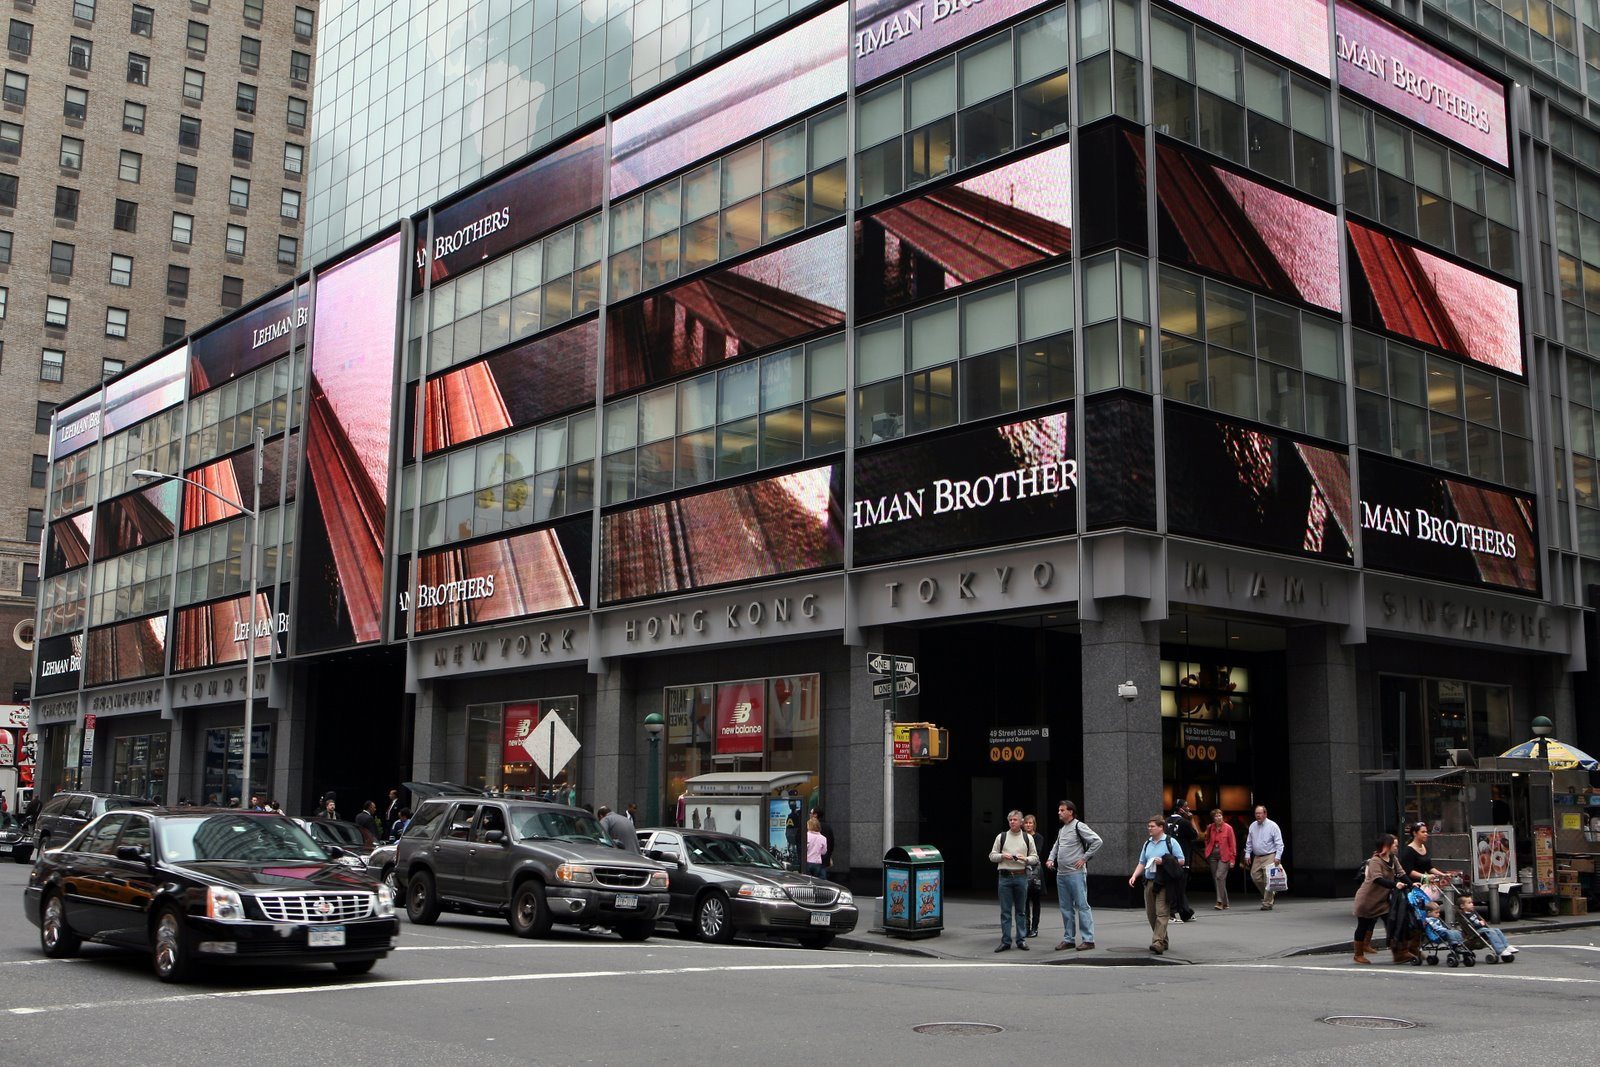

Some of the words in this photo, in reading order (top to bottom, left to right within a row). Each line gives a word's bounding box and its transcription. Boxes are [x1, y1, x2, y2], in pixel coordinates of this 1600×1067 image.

[1336, 32, 1387, 81] MAN
[1393, 56, 1490, 133] BROTHERS
[434, 206, 510, 260] BROTHERS
[252, 316, 293, 349] LEHMAN
[61, 417, 89, 443] LEHMAN
[1359, 501, 1410, 536] MAN
[1416, 508, 1516, 559] BROTHERS
[418, 575, 494, 608] BROTHERS
[885, 560, 1056, 609] TOKYO
[1184, 560, 1329, 608] MIAMI
[624, 609, 705, 642] HONG
[726, 593, 817, 630] KONG
[1381, 592, 1552, 643] SINGAPORE
[434, 640, 487, 667] NEW
[496, 628, 575, 658] YORK
[42, 659, 69, 677] LEHMAN
[874, 660, 887, 669] ONE
[895, 661, 908, 671] WAY
[878, 685, 891, 694] ONE
[898, 681, 912, 691] WAY
[721, 726, 738, 735] new
[738, 725, 762, 734] balance
[998, 729, 1017, 737] Street
[1017, 728, 1040, 736] Station
[1193, 727, 1209, 736] Street
